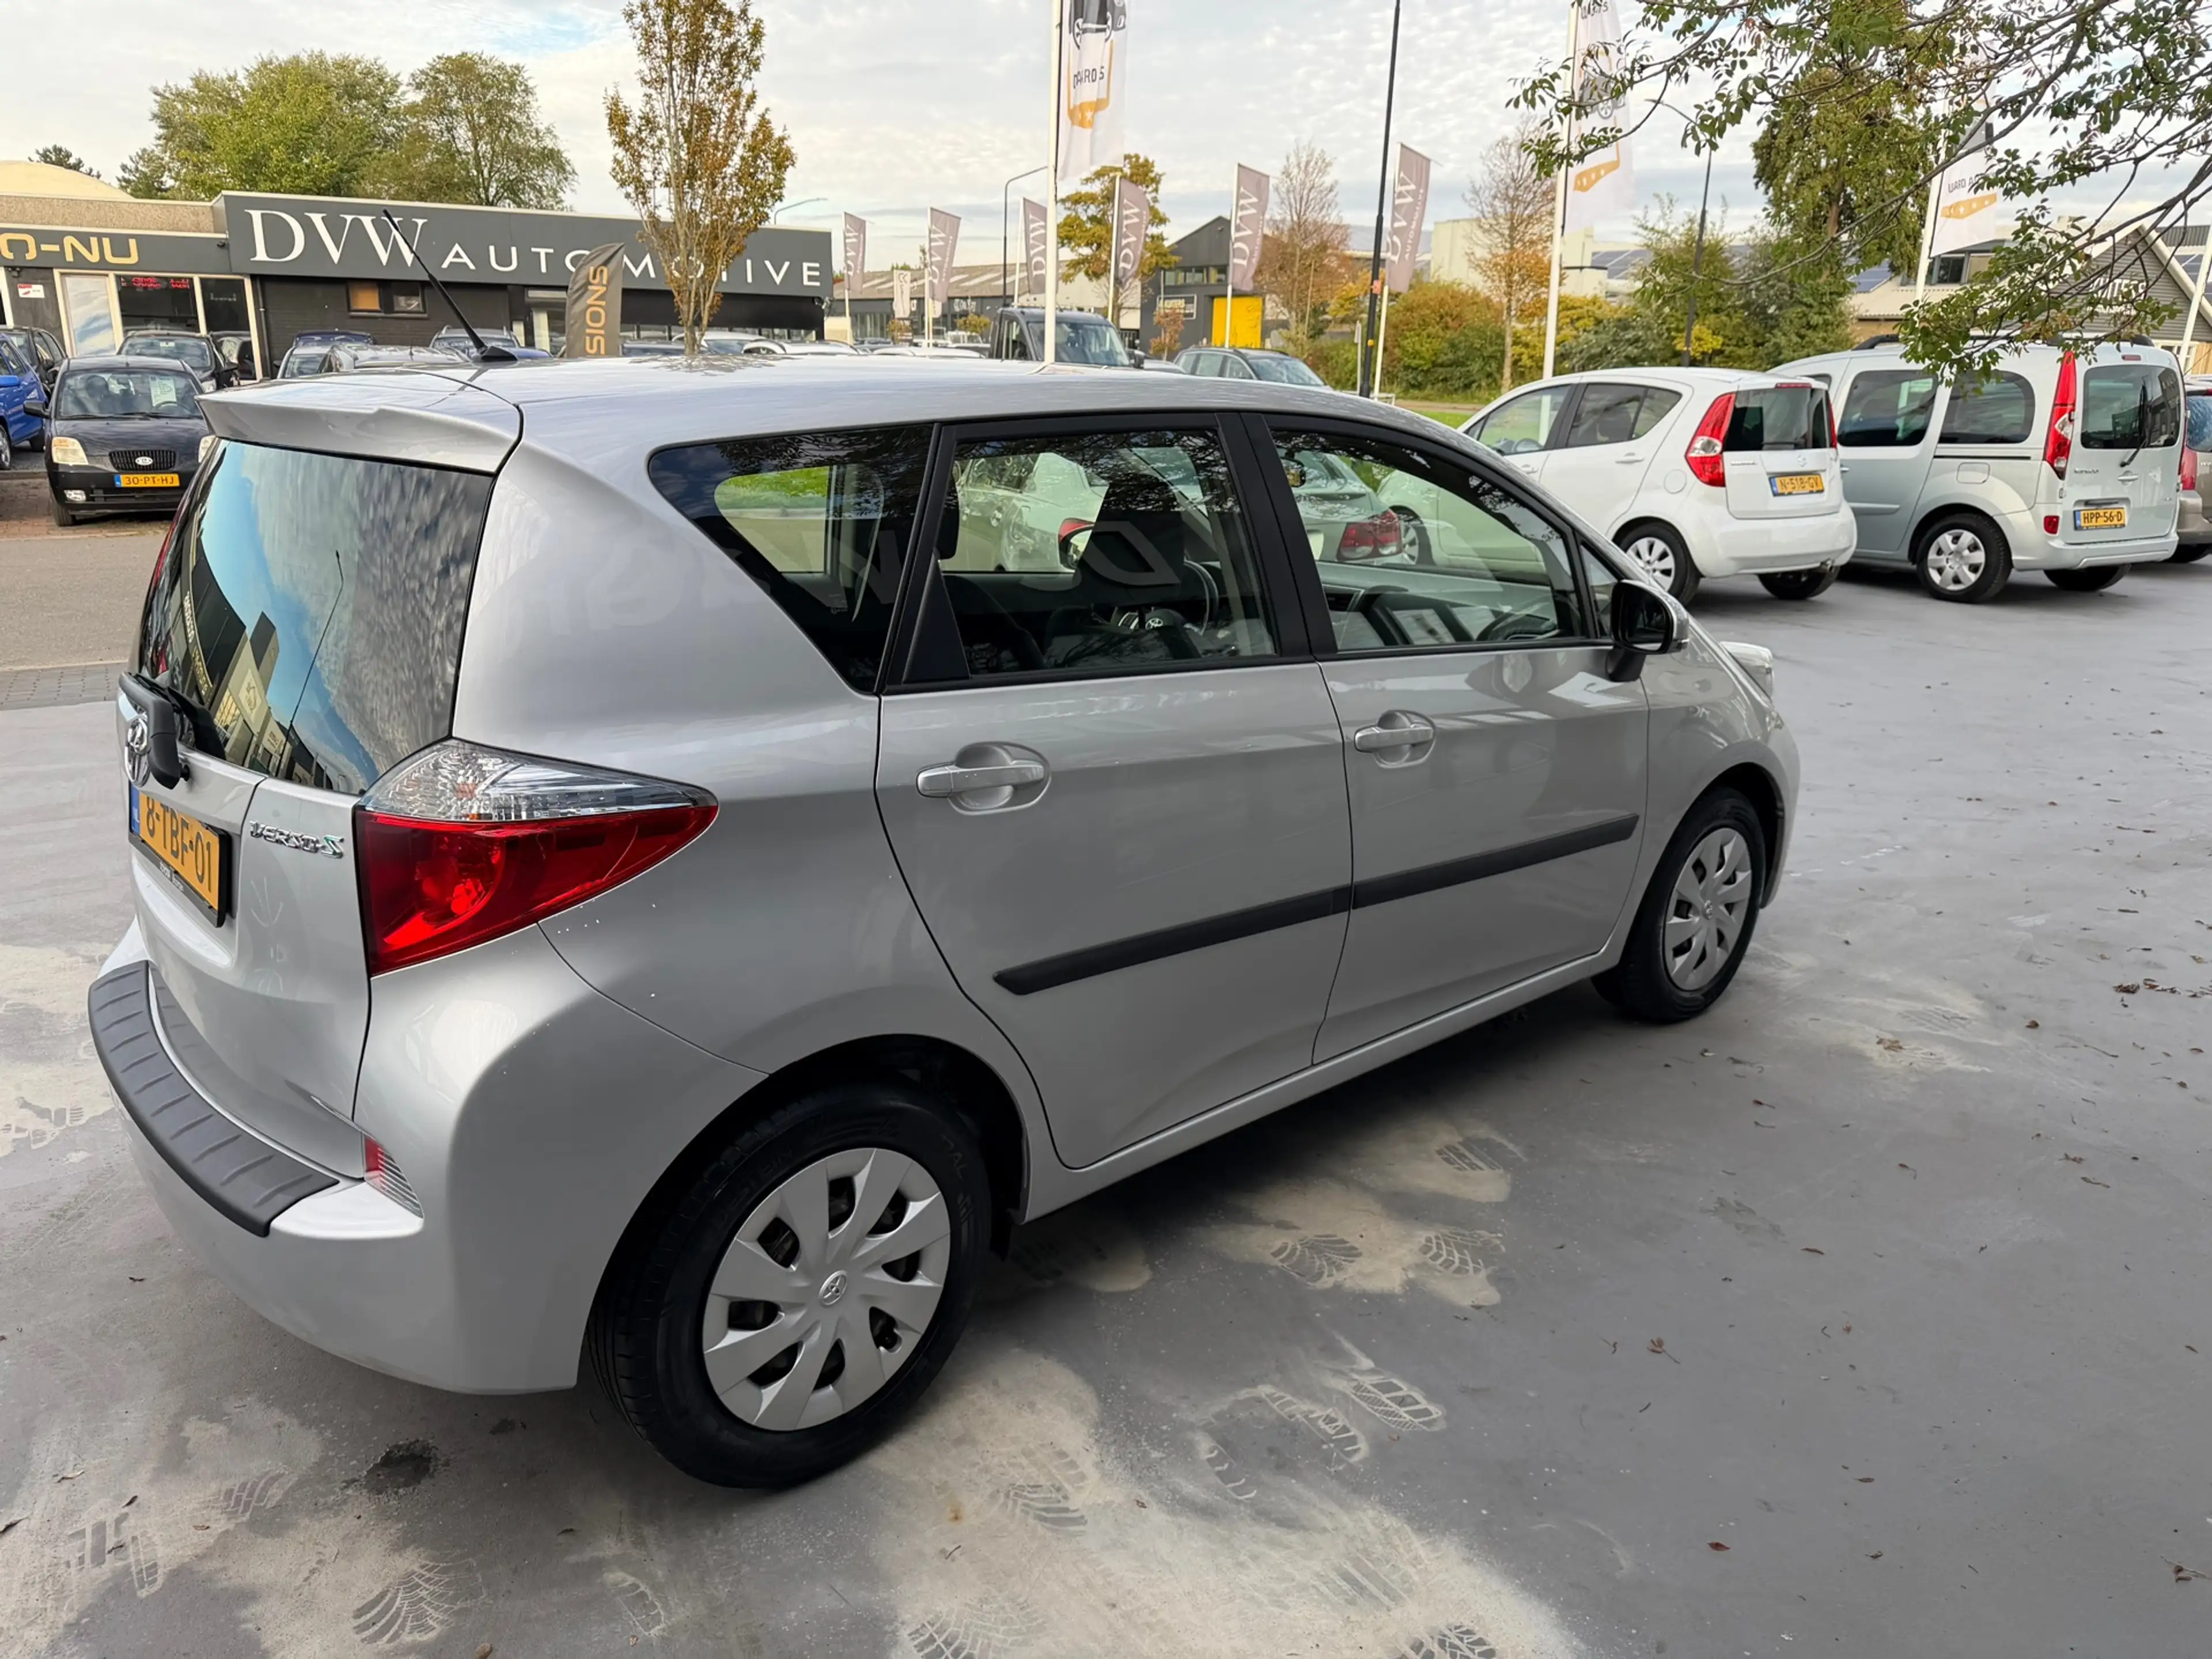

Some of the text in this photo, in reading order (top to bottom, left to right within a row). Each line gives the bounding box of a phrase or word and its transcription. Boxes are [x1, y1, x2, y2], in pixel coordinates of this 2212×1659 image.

[244, 209, 428, 267] DVW
[1029, 213, 1046, 276] DVW
[1119, 199, 1141, 270] DVW
[1233, 185, 1259, 267] DVW
[585, 266, 608, 355] SIONS
[124, 476, 175, 485] 30-PT-HJ
[2083, 512, 2123, 524] HPP-56-D
[146, 796, 211, 893] 8-TBF-01
